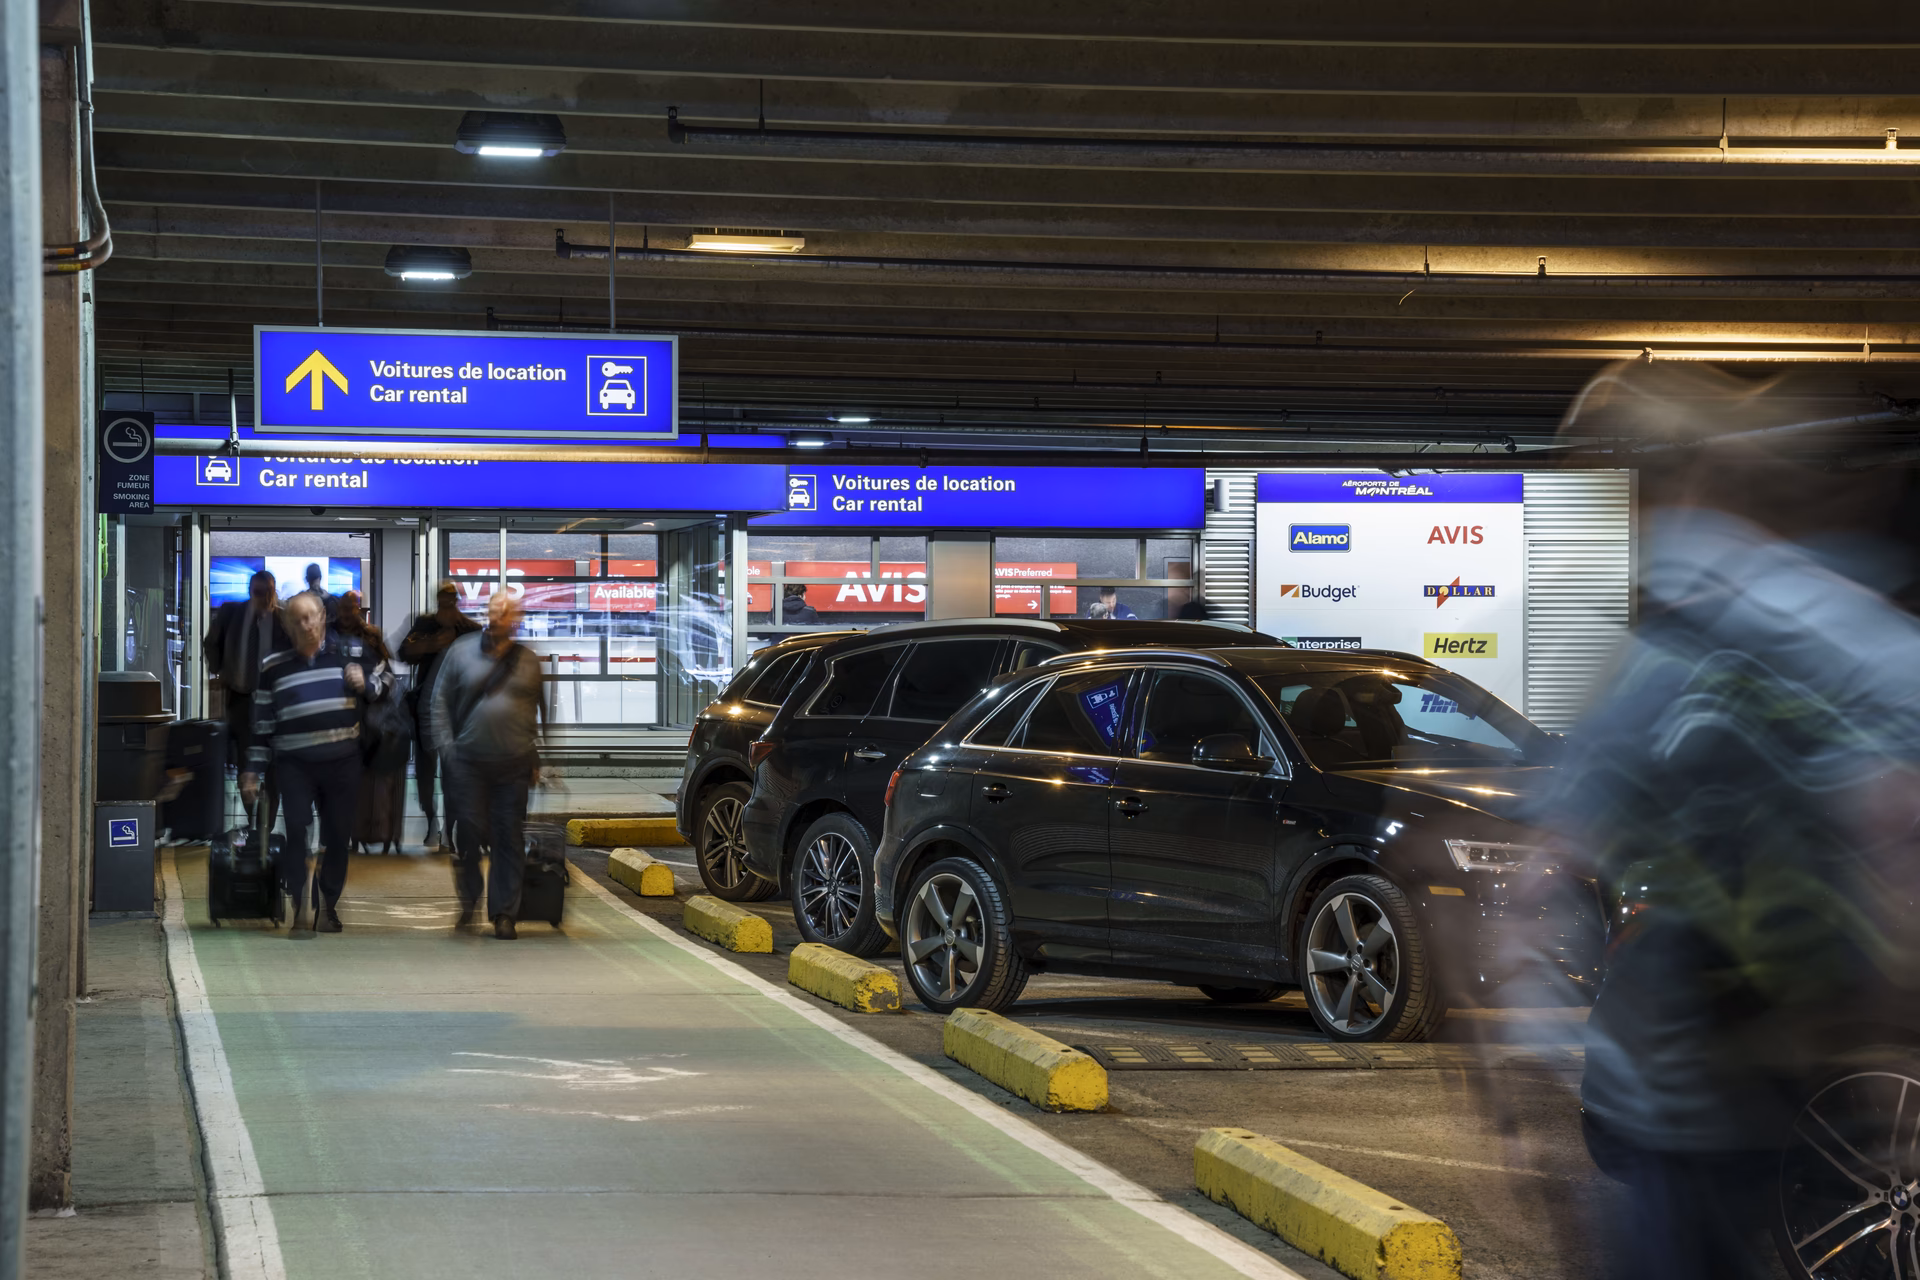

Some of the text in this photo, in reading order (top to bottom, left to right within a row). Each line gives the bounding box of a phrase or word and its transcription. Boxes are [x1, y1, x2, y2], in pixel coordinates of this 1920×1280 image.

[369, 360, 567, 381] Voitures de location
[369, 384, 468, 403] Car rental
[117, 481, 150, 489] FUMEUR
[128, 474, 150, 482] ZONE
[259, 469, 368, 488] Car rental
[832, 474, 1016, 492] Voitures de location
[113, 493, 150, 501] SMOKING
[1355, 485, 1434, 496] MONTRÉAL
[832, 495, 923, 512] Car rental
[1293, 531, 1348, 545] Alamo
[1427, 525, 1484, 545] AVIS
[594, 586, 654, 599] Available
[836, 571, 926, 603] AVIS
[1302, 584, 1357, 602] Budget
[1426, 585, 1493, 597] DOLLAR
[1433, 637, 1487, 654] Hertz
